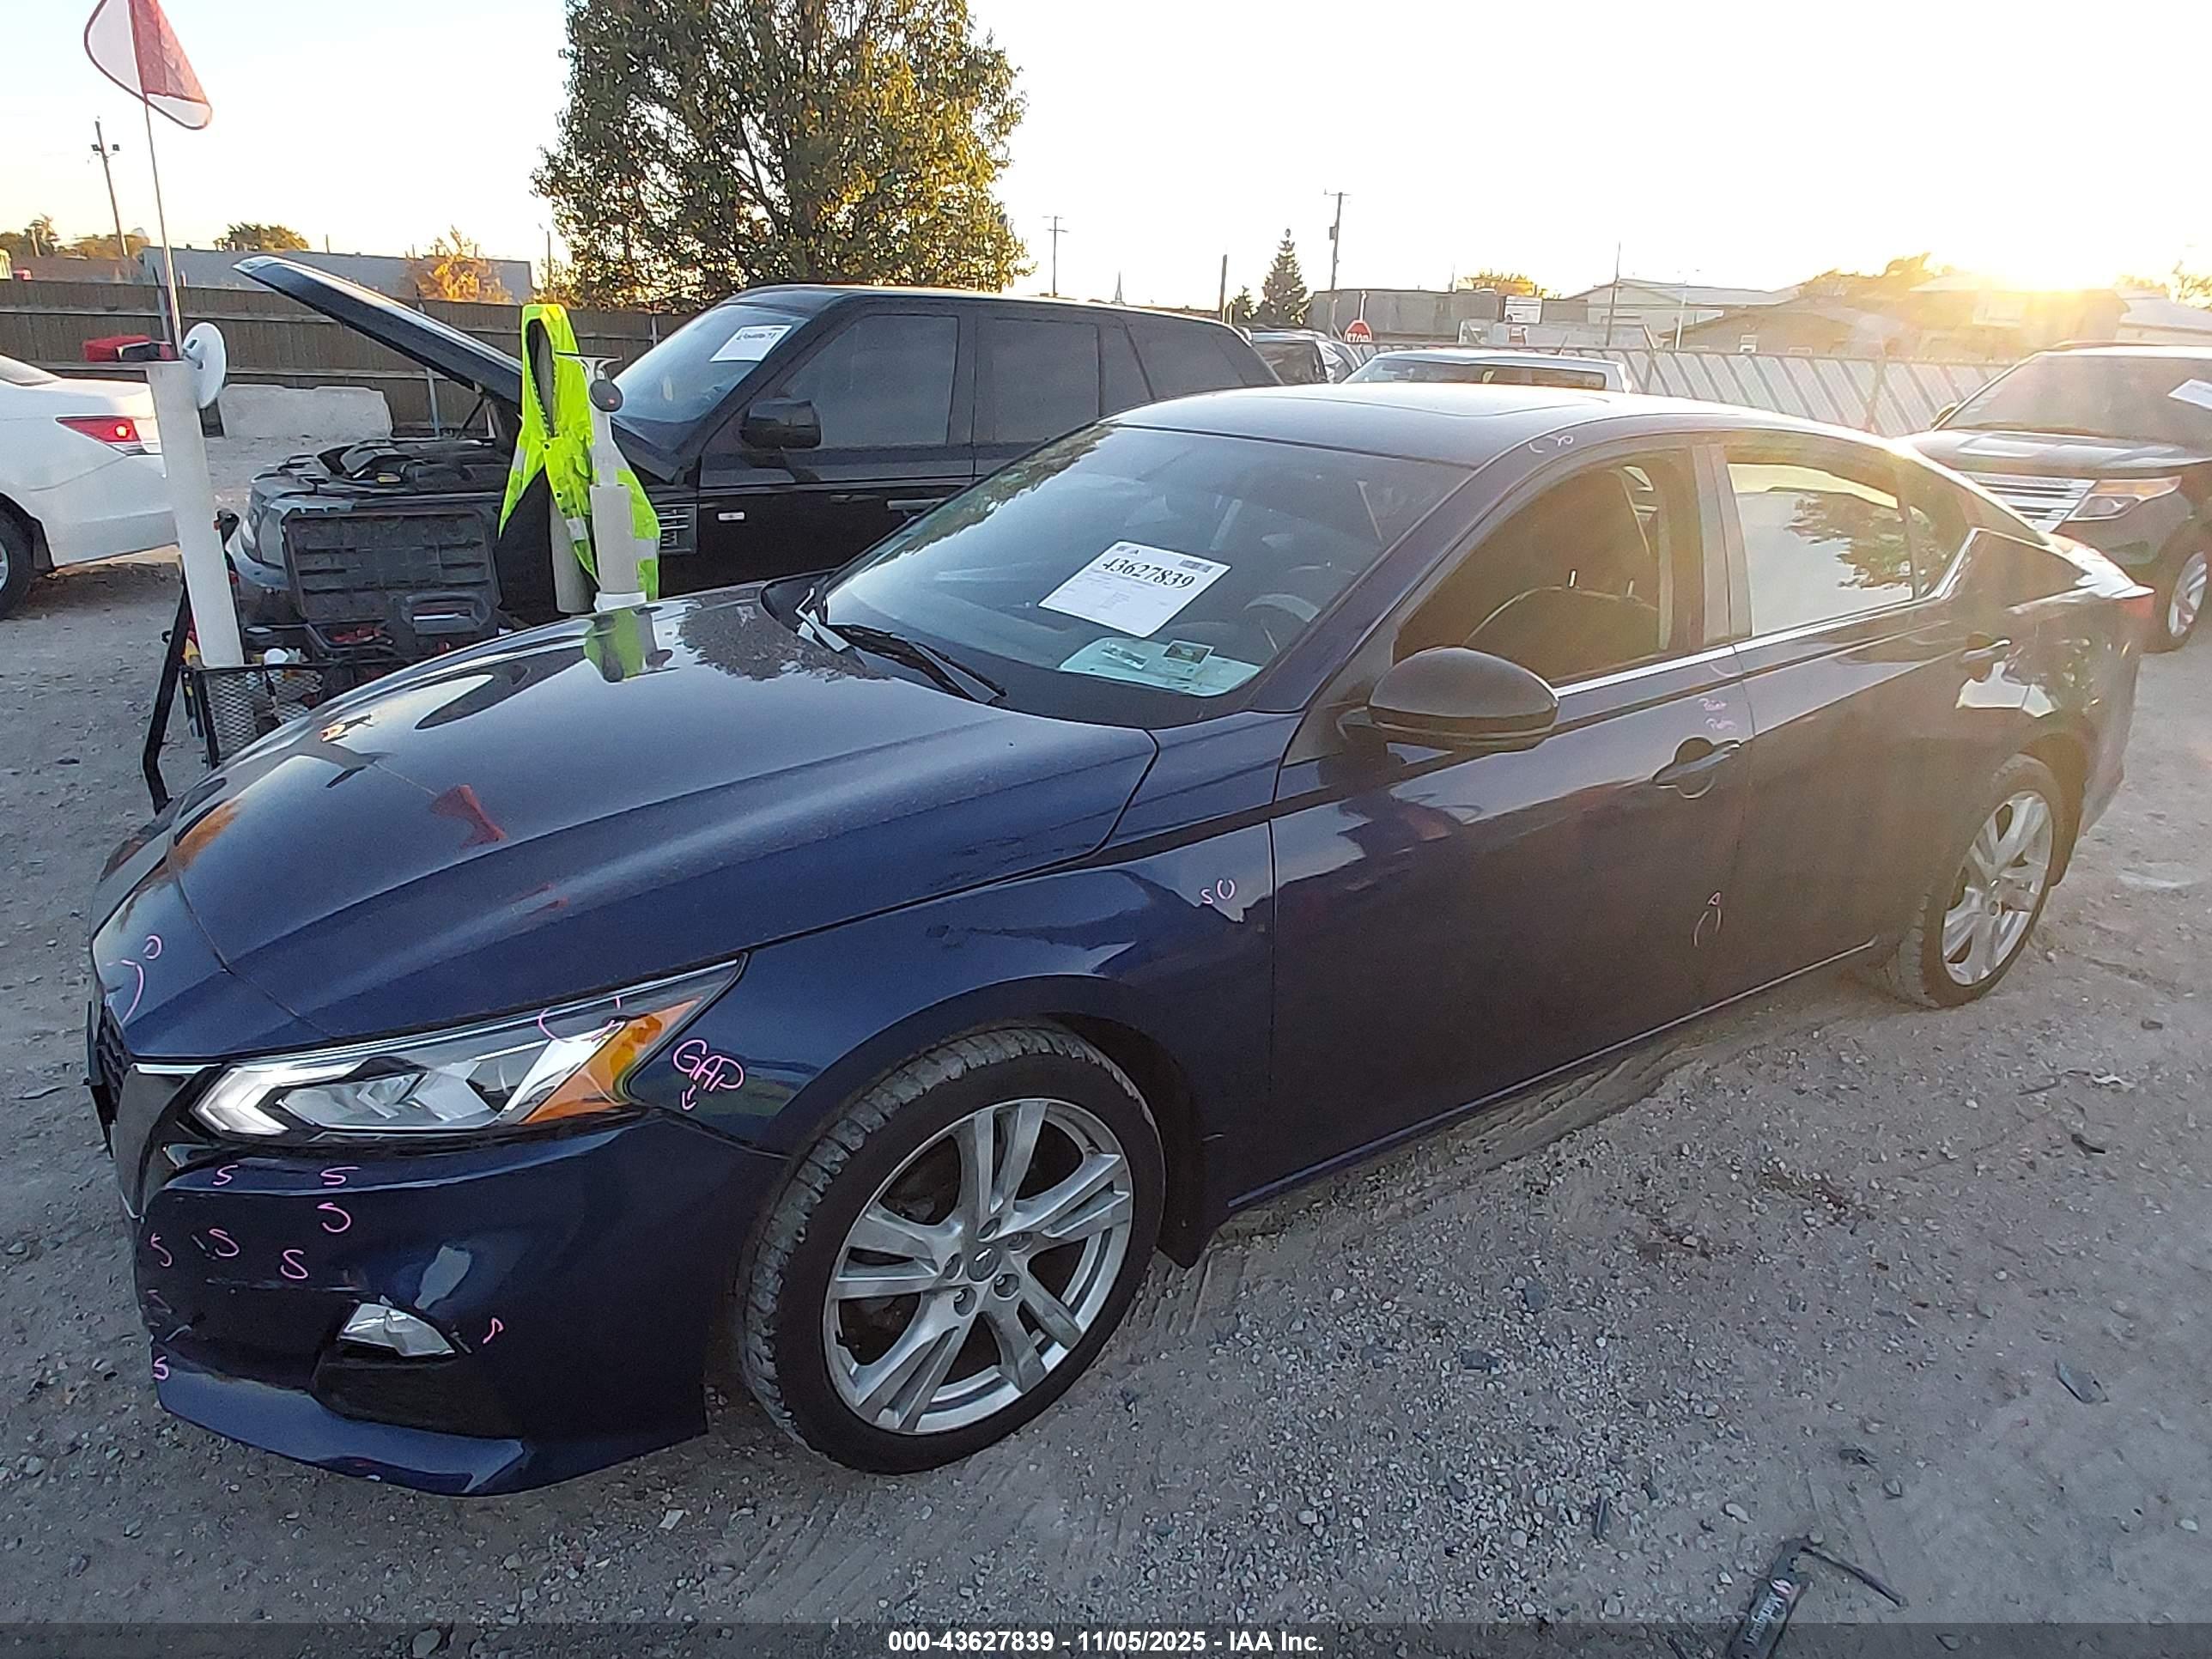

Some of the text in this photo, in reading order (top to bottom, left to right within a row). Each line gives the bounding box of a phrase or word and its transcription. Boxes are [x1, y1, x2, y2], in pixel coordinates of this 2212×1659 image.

[1102, 556, 1195, 589] 43627839
[672, 1039, 744, 1092] GAP
[280, 1249, 309, 1279] S
